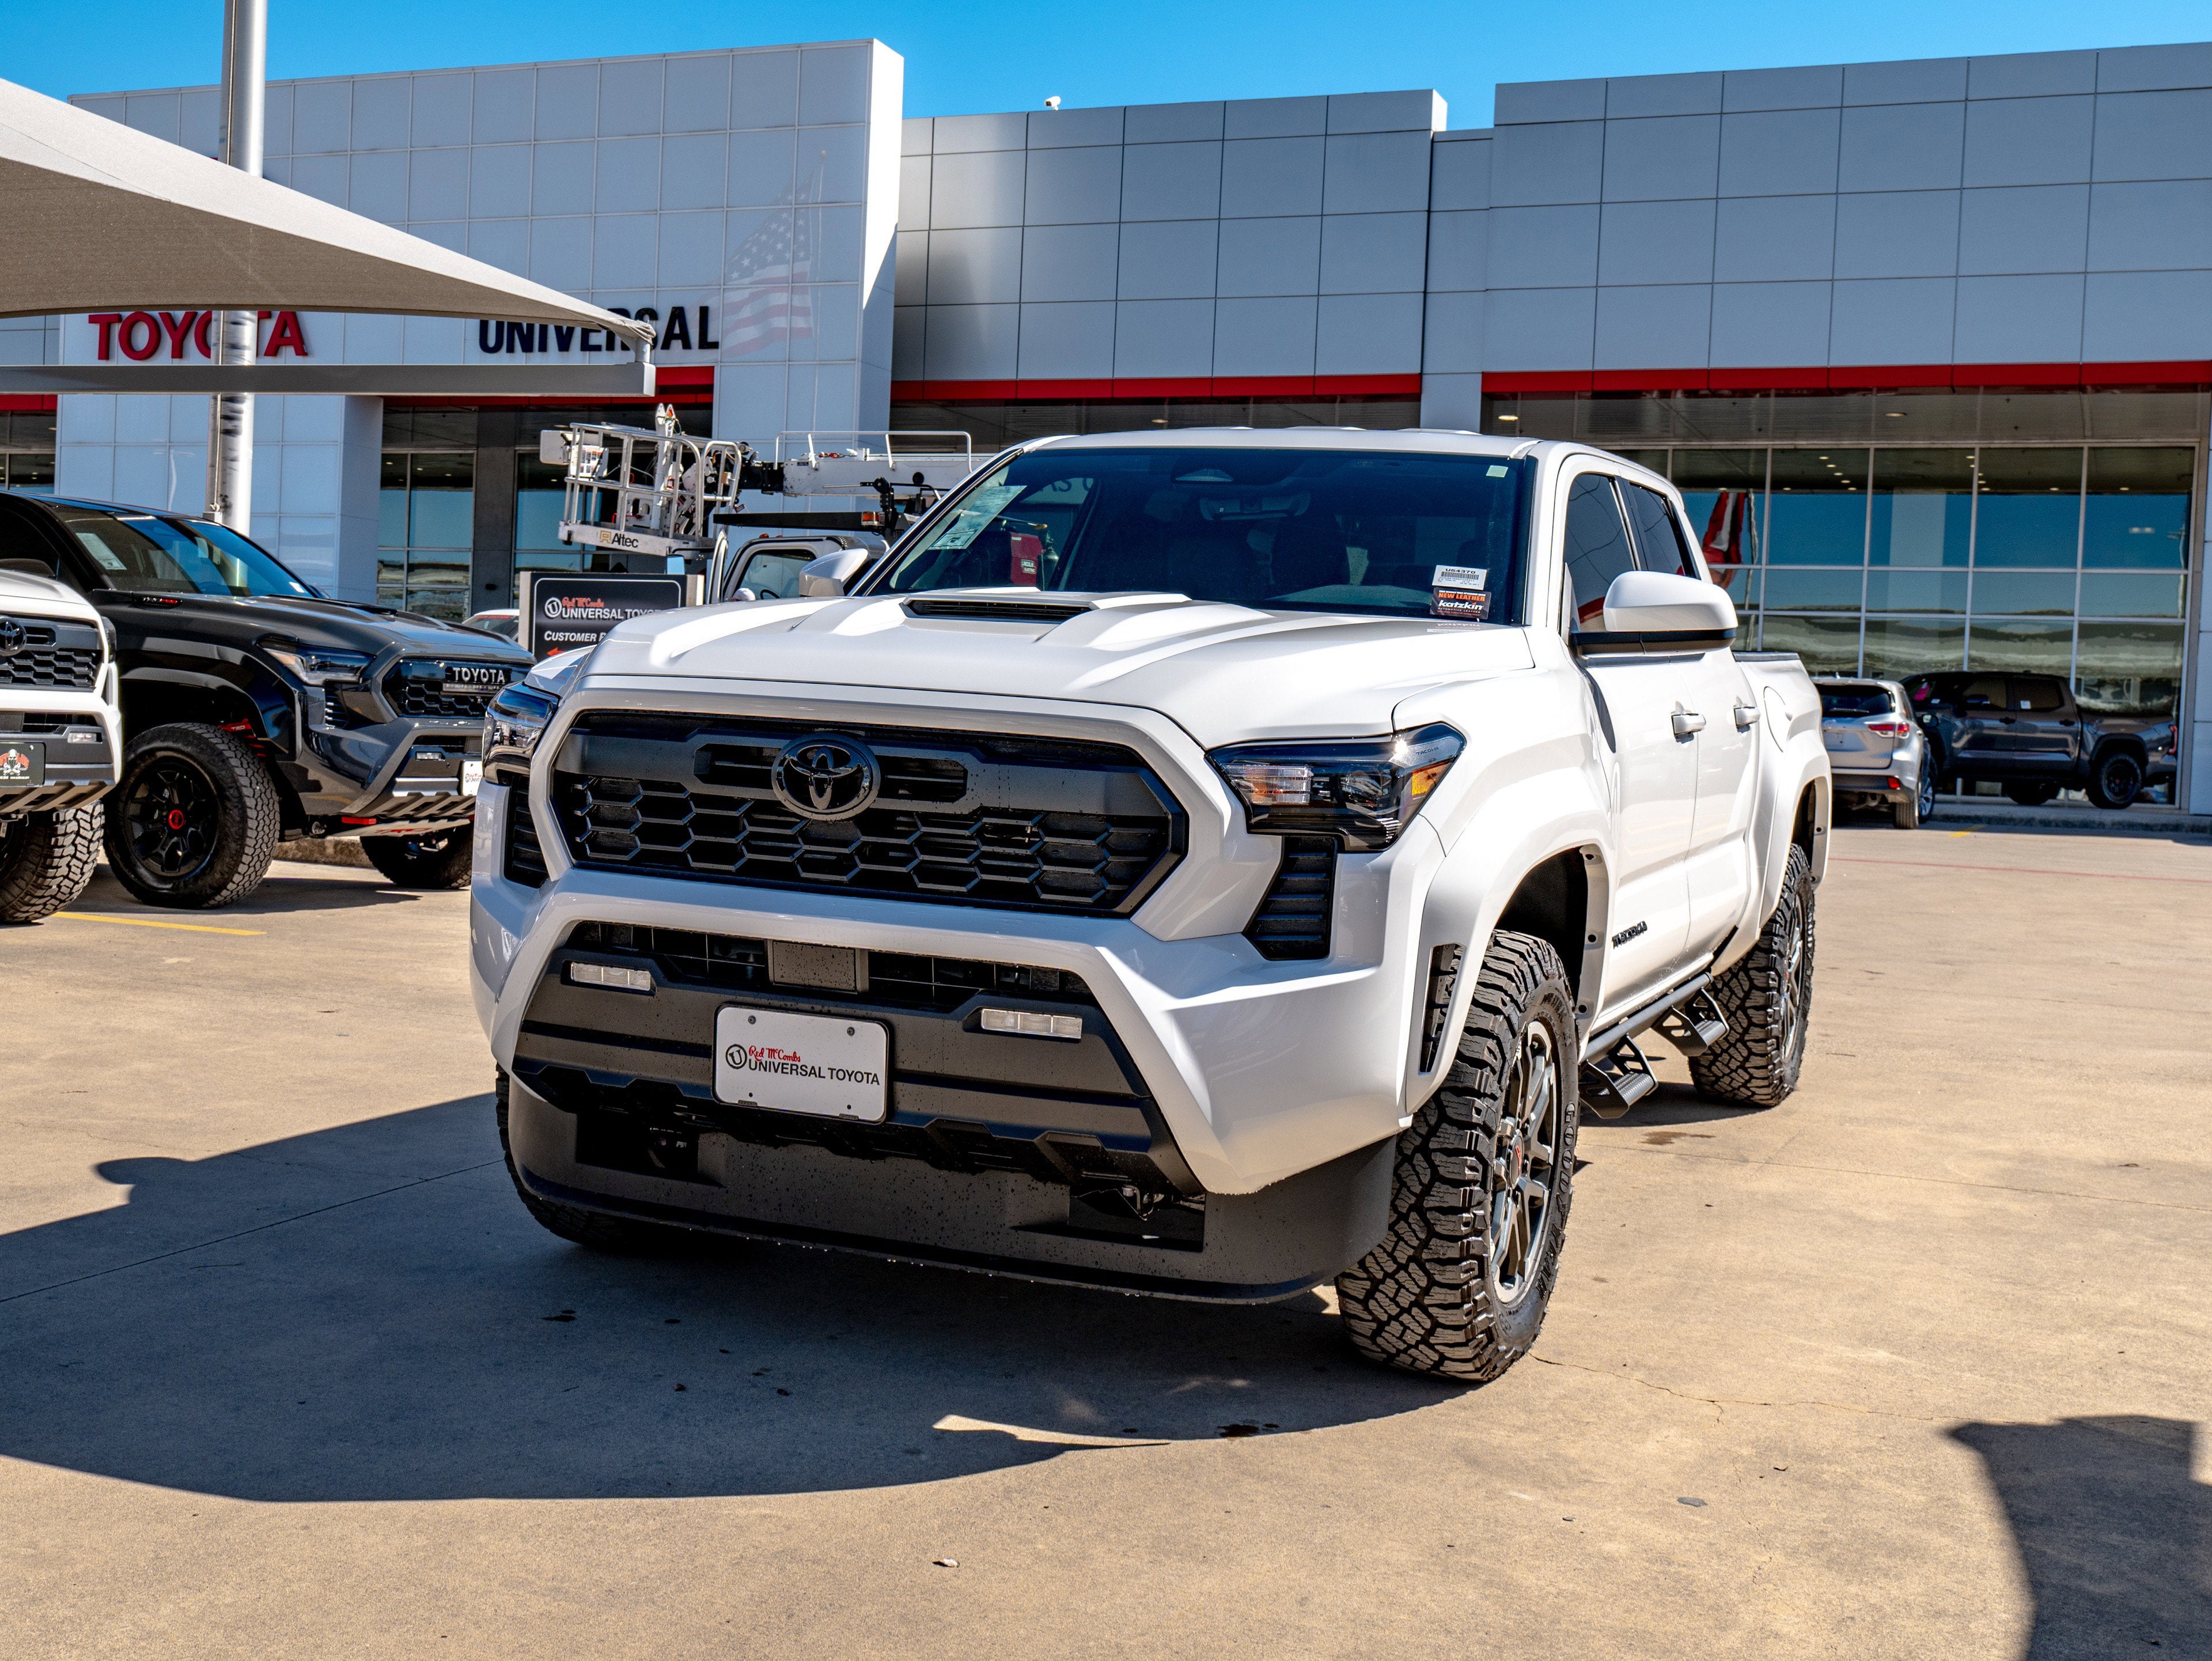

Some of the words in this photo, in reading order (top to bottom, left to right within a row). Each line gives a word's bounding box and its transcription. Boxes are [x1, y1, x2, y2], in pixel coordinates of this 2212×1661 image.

[611, 533, 639, 548] Altec
[1456, 593, 1486, 601] LEATHER
[1438, 600, 1483, 610] katzkin
[562, 608, 624, 619] UNIVERSAL
[544, 631, 597, 642] CUSTOMER
[453, 667, 505, 684] TOYOTA
[1416, 747, 1439, 755] TACOMA
[748, 1045, 764, 1062] Red
[766, 1047, 801, 1062] McCombs
[748, 1059, 825, 1079] UNIVERSAL
[827, 1067, 880, 1085] TOYOTA
